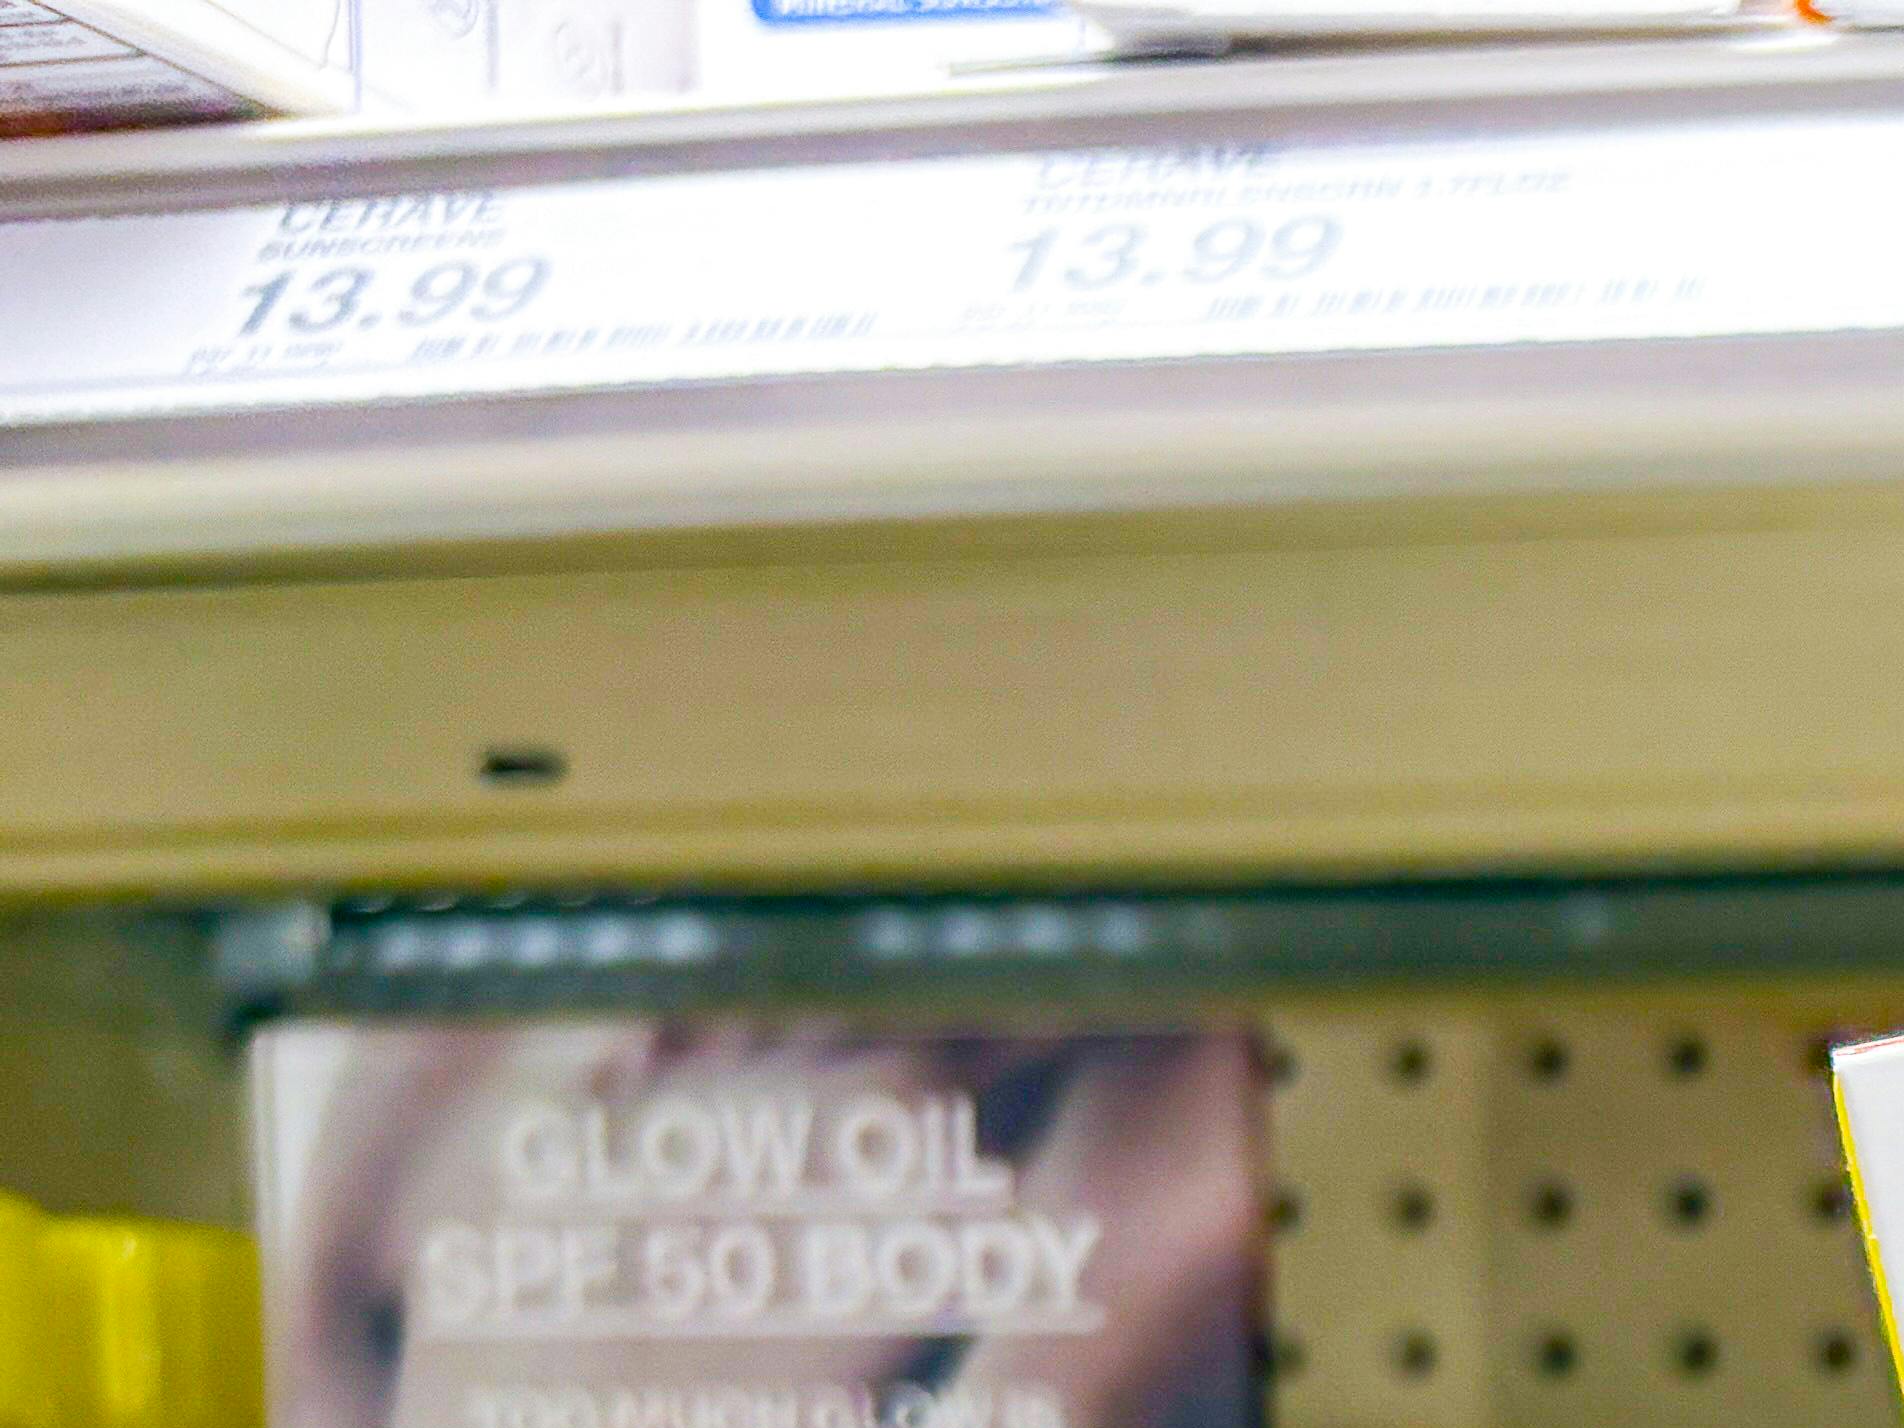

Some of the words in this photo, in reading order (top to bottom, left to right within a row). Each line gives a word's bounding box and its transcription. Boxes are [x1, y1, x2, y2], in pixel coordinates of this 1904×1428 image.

[236, 252, 554, 338] 13.99
[1006, 212, 1346, 294] 13.99
[503, 1093, 815, 1200] GLOW
[833, 1093, 1015, 1202] OIL
[420, 1218, 617, 1325] SPF
[640, 1220, 778, 1318] 50
[805, 1210, 1103, 1318] BODY
